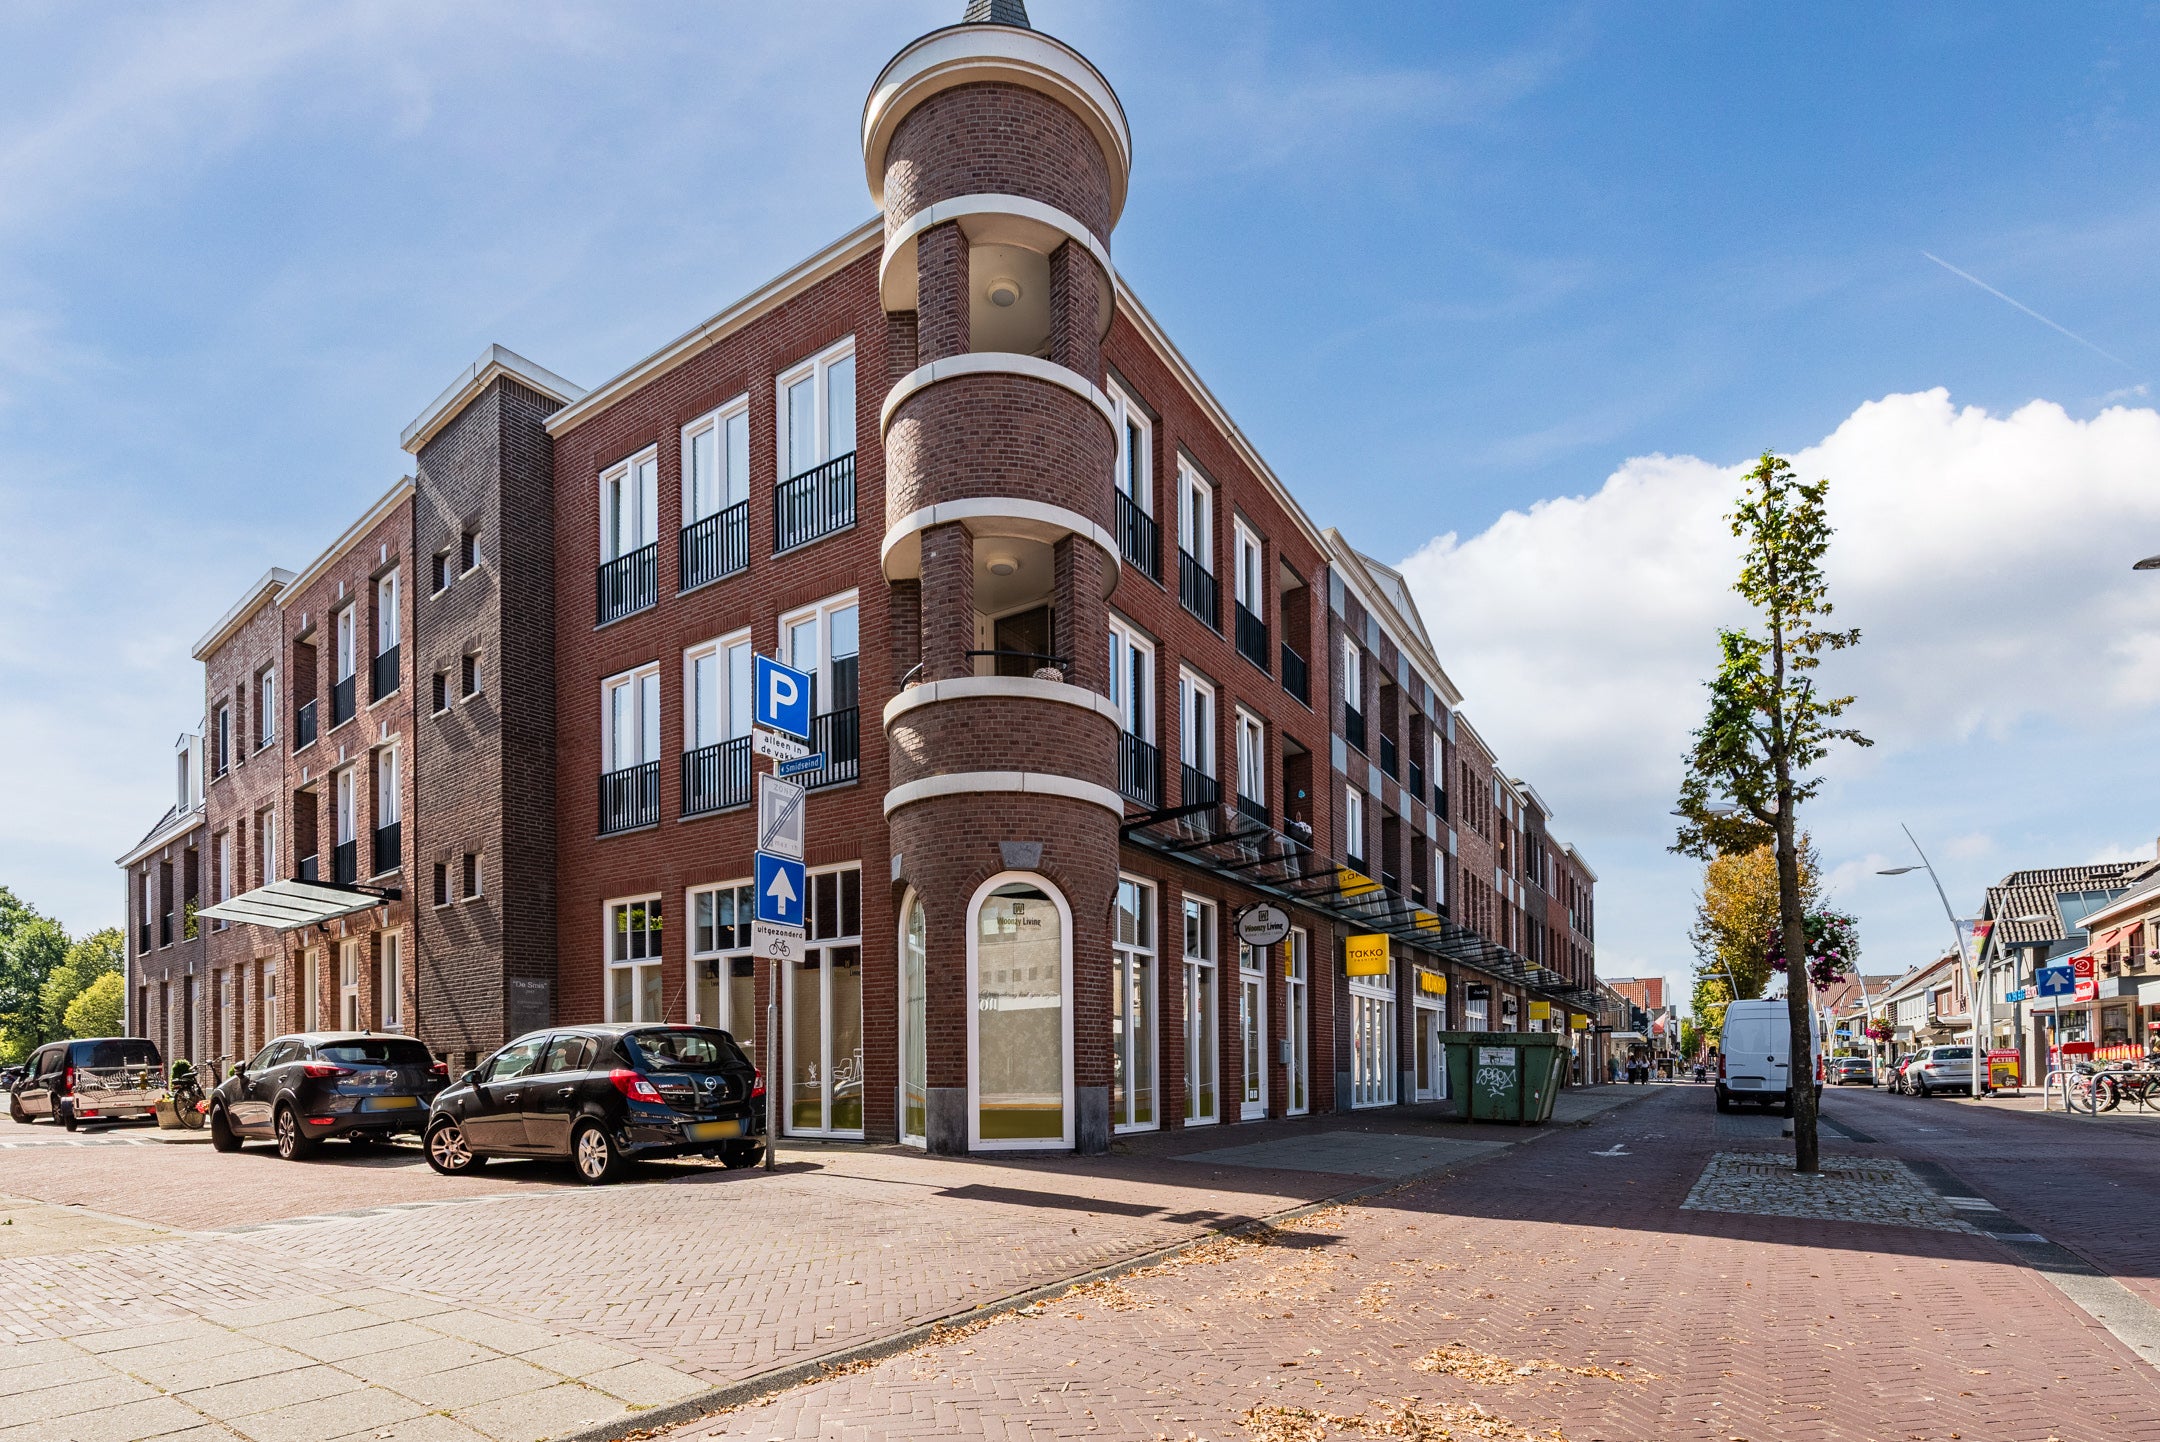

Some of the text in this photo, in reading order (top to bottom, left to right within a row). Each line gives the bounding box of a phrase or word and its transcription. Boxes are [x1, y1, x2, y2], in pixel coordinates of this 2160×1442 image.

[769, 669, 798, 719] P
[761, 745, 771, 755] de
[764, 735, 802, 755] alleen in
[785, 758, 819, 773] Smidseind
[1022, 917, 1042, 927] Living
[1266, 922, 1284, 931] Living
[757, 926, 803, 939] uitgezonderd
[1349, 948, 1384, 959] TAKKO
